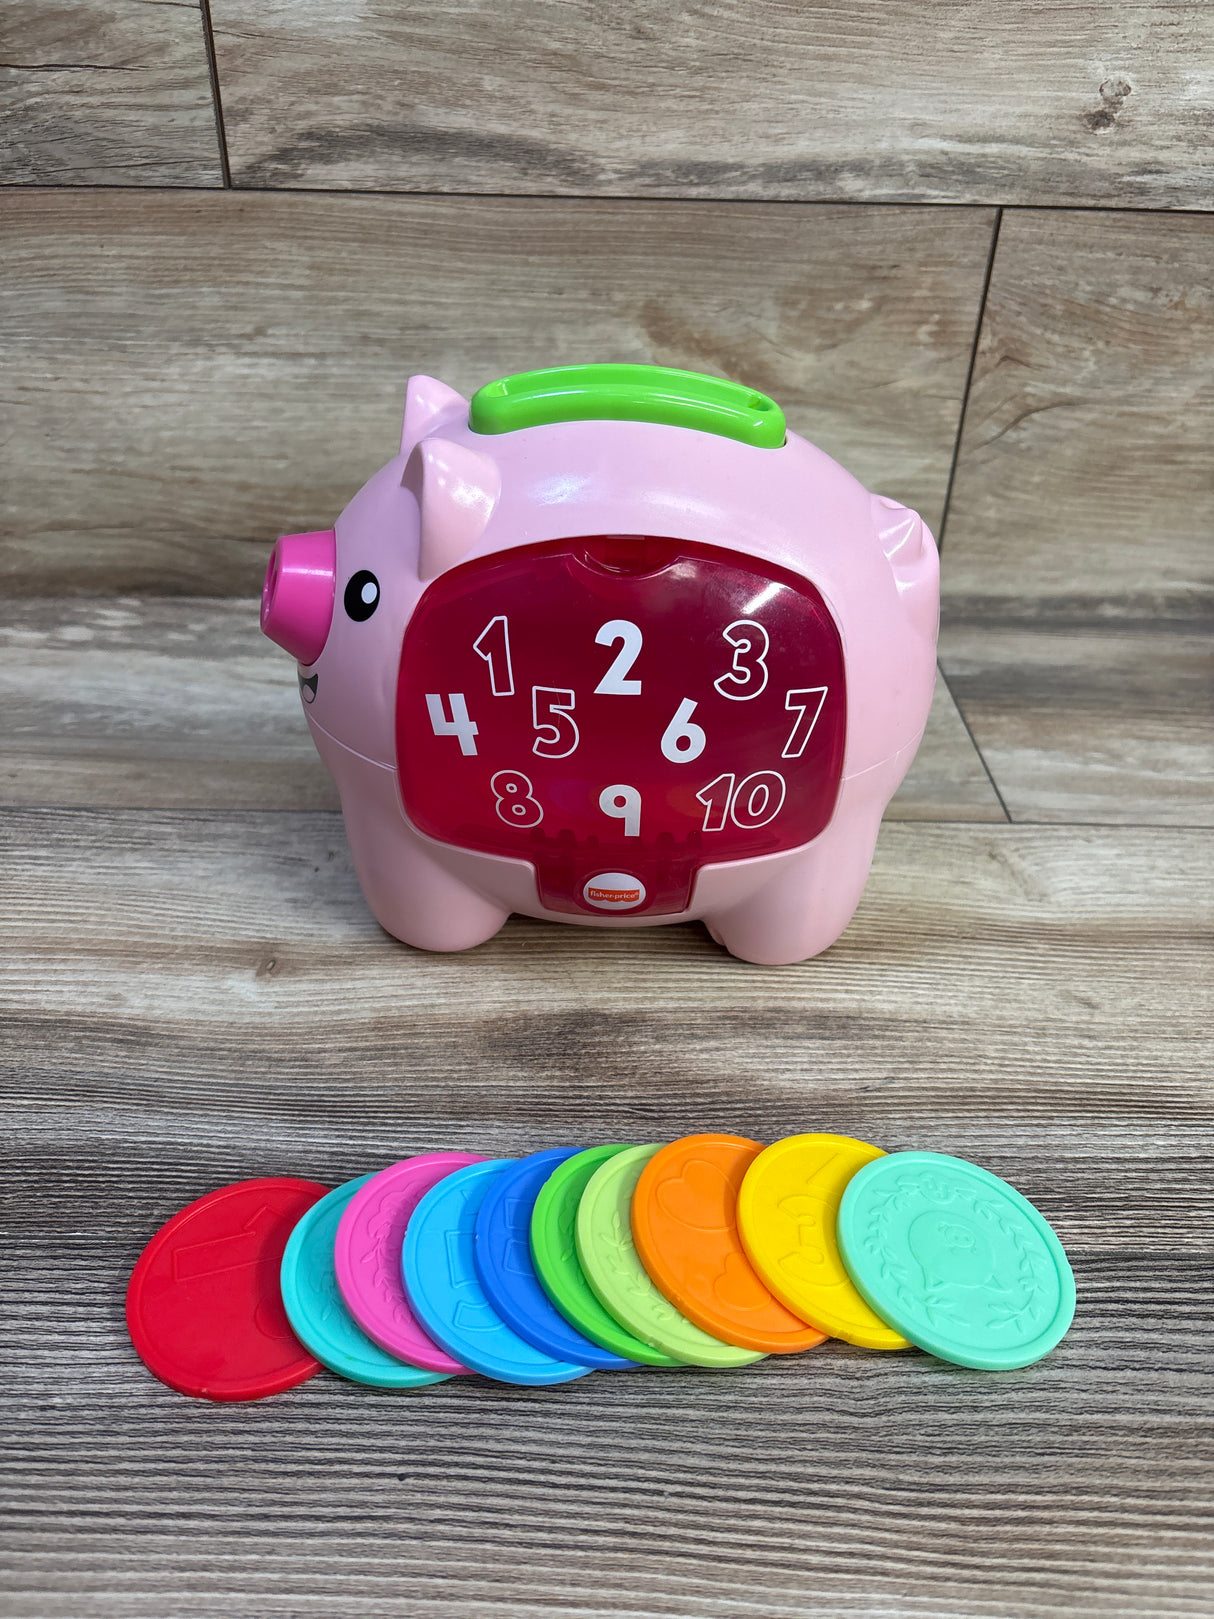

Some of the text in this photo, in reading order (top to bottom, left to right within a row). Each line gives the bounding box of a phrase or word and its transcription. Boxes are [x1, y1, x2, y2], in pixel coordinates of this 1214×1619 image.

[473, 616, 769, 700] 1 2 3
[425, 686, 828, 763] 4 5 6 7
[491, 770, 786, 836] 8 9 10
